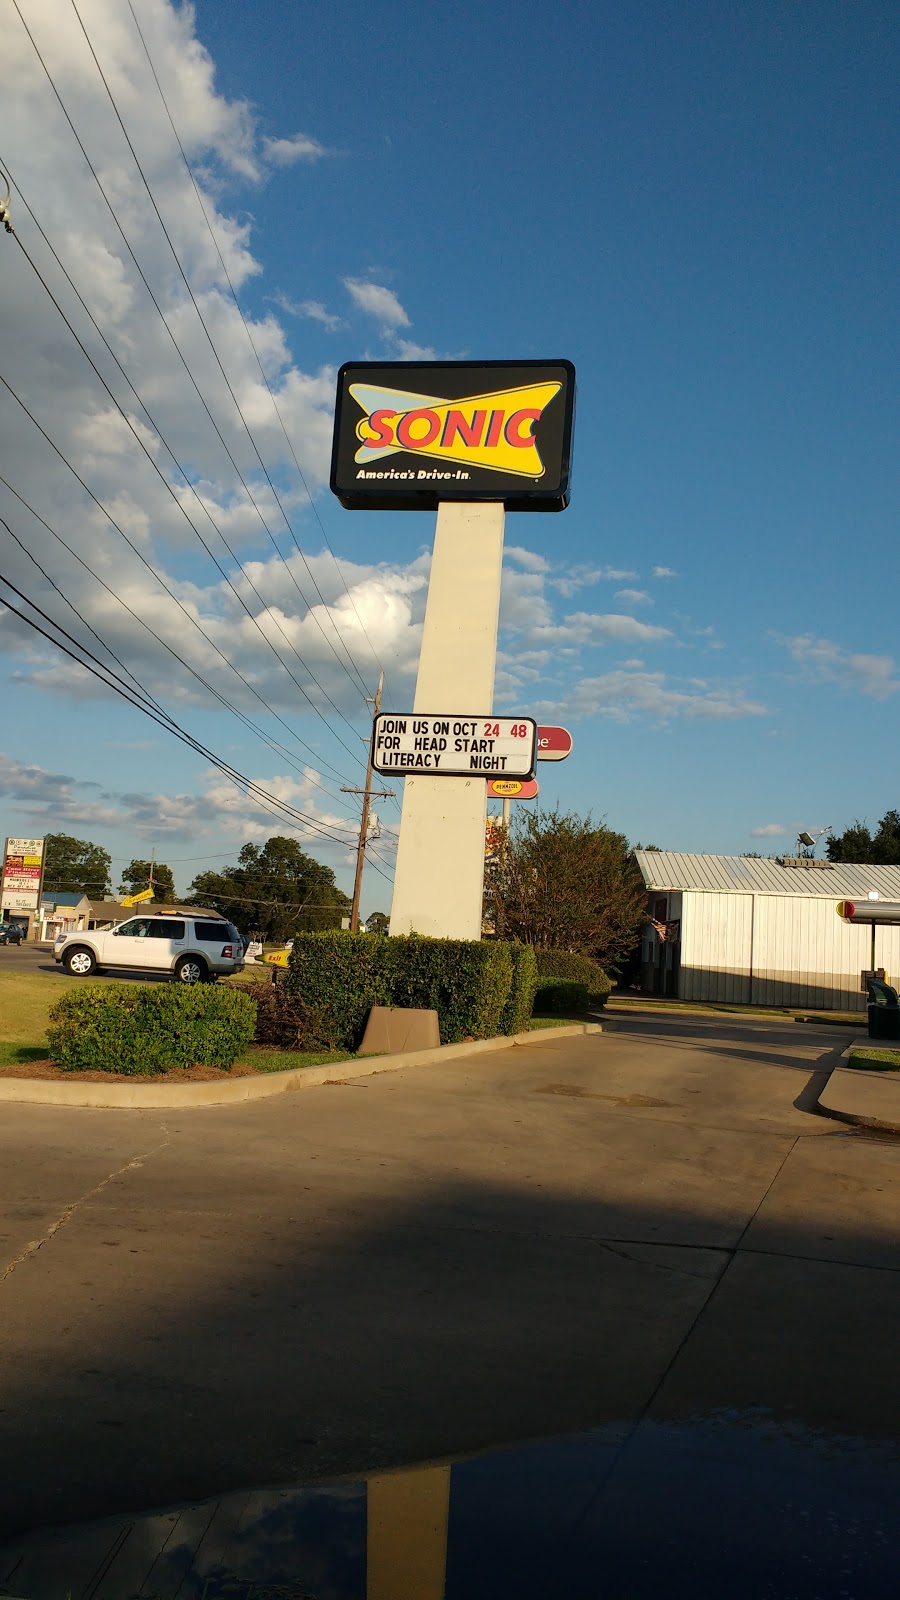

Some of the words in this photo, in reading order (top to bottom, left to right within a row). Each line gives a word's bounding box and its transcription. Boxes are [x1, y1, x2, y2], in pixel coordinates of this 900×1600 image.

[362, 408, 542, 449] SONIC
[356, 469, 415, 480] America's
[380, 720, 407, 734] JOIN
[412, 721, 429, 735] US
[433, 721, 449, 735] ON
[453, 722, 478, 736] OCT
[483, 723, 500, 737] 24
[510, 724, 527, 738] 48
[377, 736, 401, 750] FOR
[414, 737, 447, 751] HEAD
[454, 739, 495, 753] START
[382, 753, 441, 767] LITERACY
[470, 756, 508, 770] NIGHT
